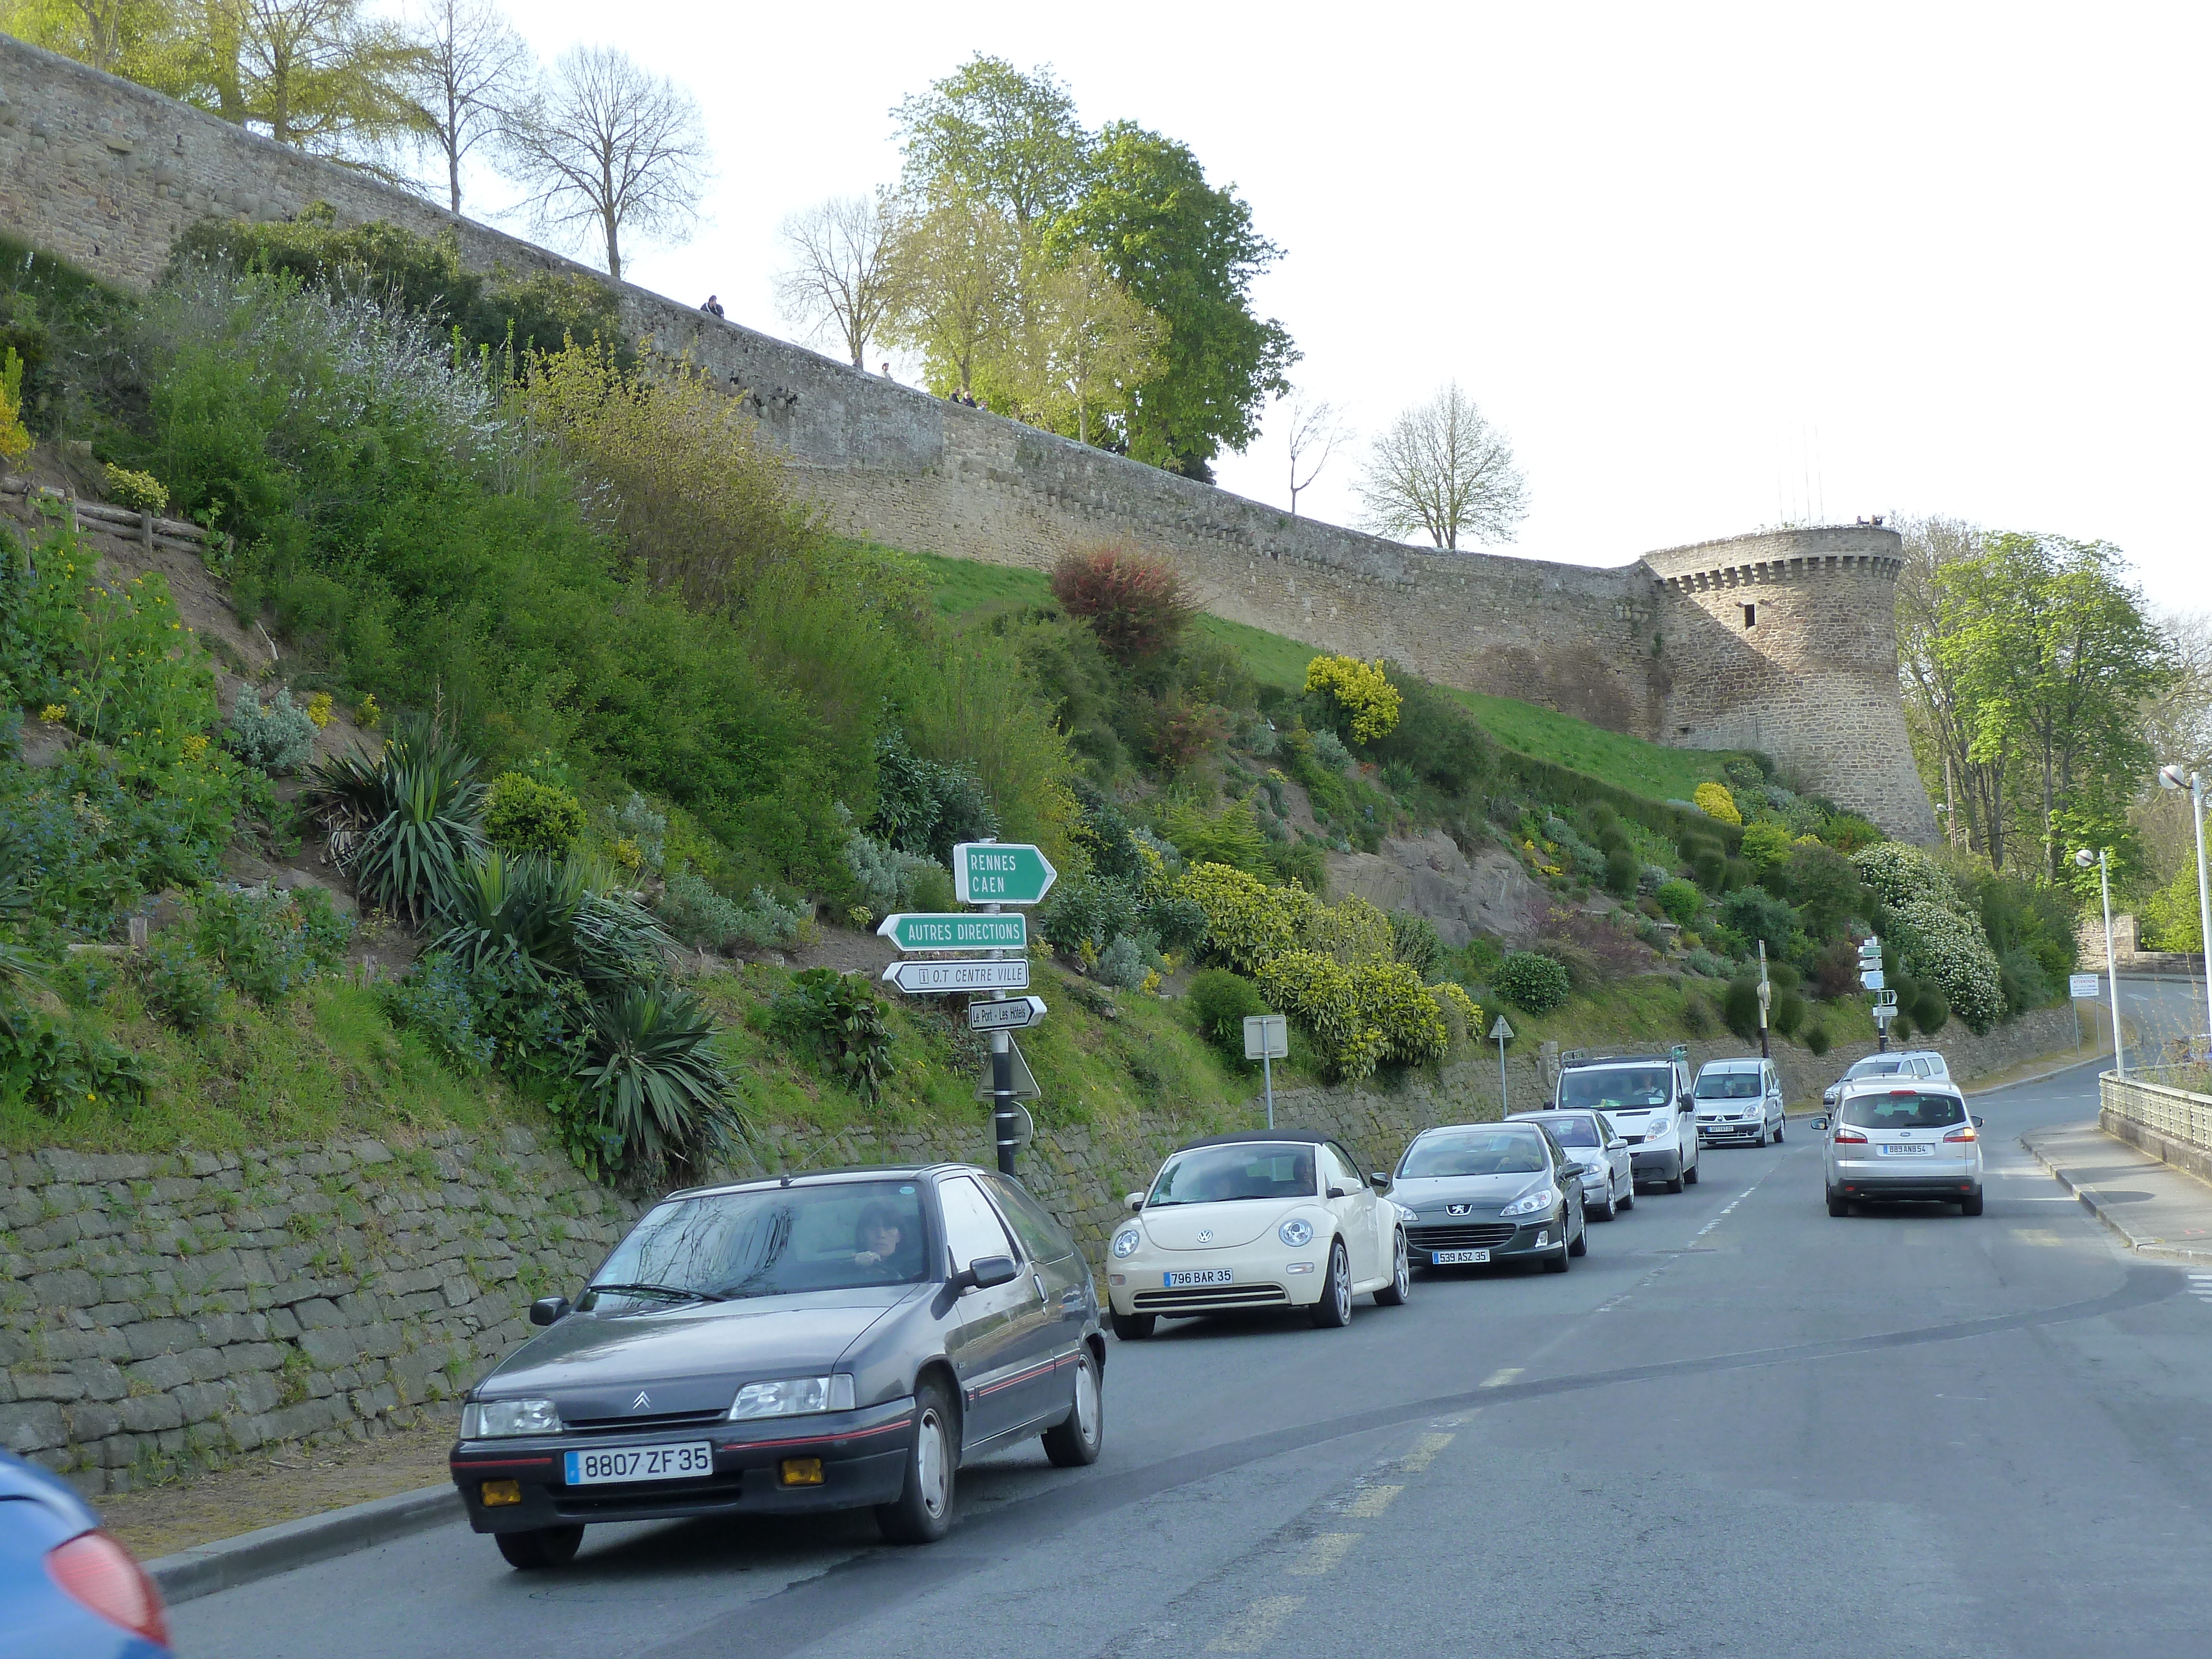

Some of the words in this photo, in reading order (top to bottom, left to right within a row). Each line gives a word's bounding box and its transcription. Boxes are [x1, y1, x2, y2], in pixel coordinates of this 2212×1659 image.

[971, 854, 1016, 872] RENNES
[972, 877, 1005, 893] CAEN
[909, 924, 952, 941] AUTRES
[957, 923, 1020, 940] DIRECTIONS
[955, 968, 992, 982] CENTRE
[998, 967, 1022, 981] VILLE
[973, 1010, 980, 1023] Le
[981, 1008, 993, 1022] Port
[999, 1007, 1009, 1021] Les
[1010, 1005, 1026, 1020] Hôtels
[1440, 1253, 1455, 1262] 539
[1458, 1252, 1473, 1261] ASZ
[1475, 1251, 1485, 1260] 35
[1171, 1272, 1191, 1285] 796
[1194, 1271, 1214, 1283] BAR
[1217, 1270, 1231, 1281] 35
[585, 1452, 641, 1478] 8807
[646, 1449, 674, 1474] ZF
[678, 1447, 708, 1471] 35
